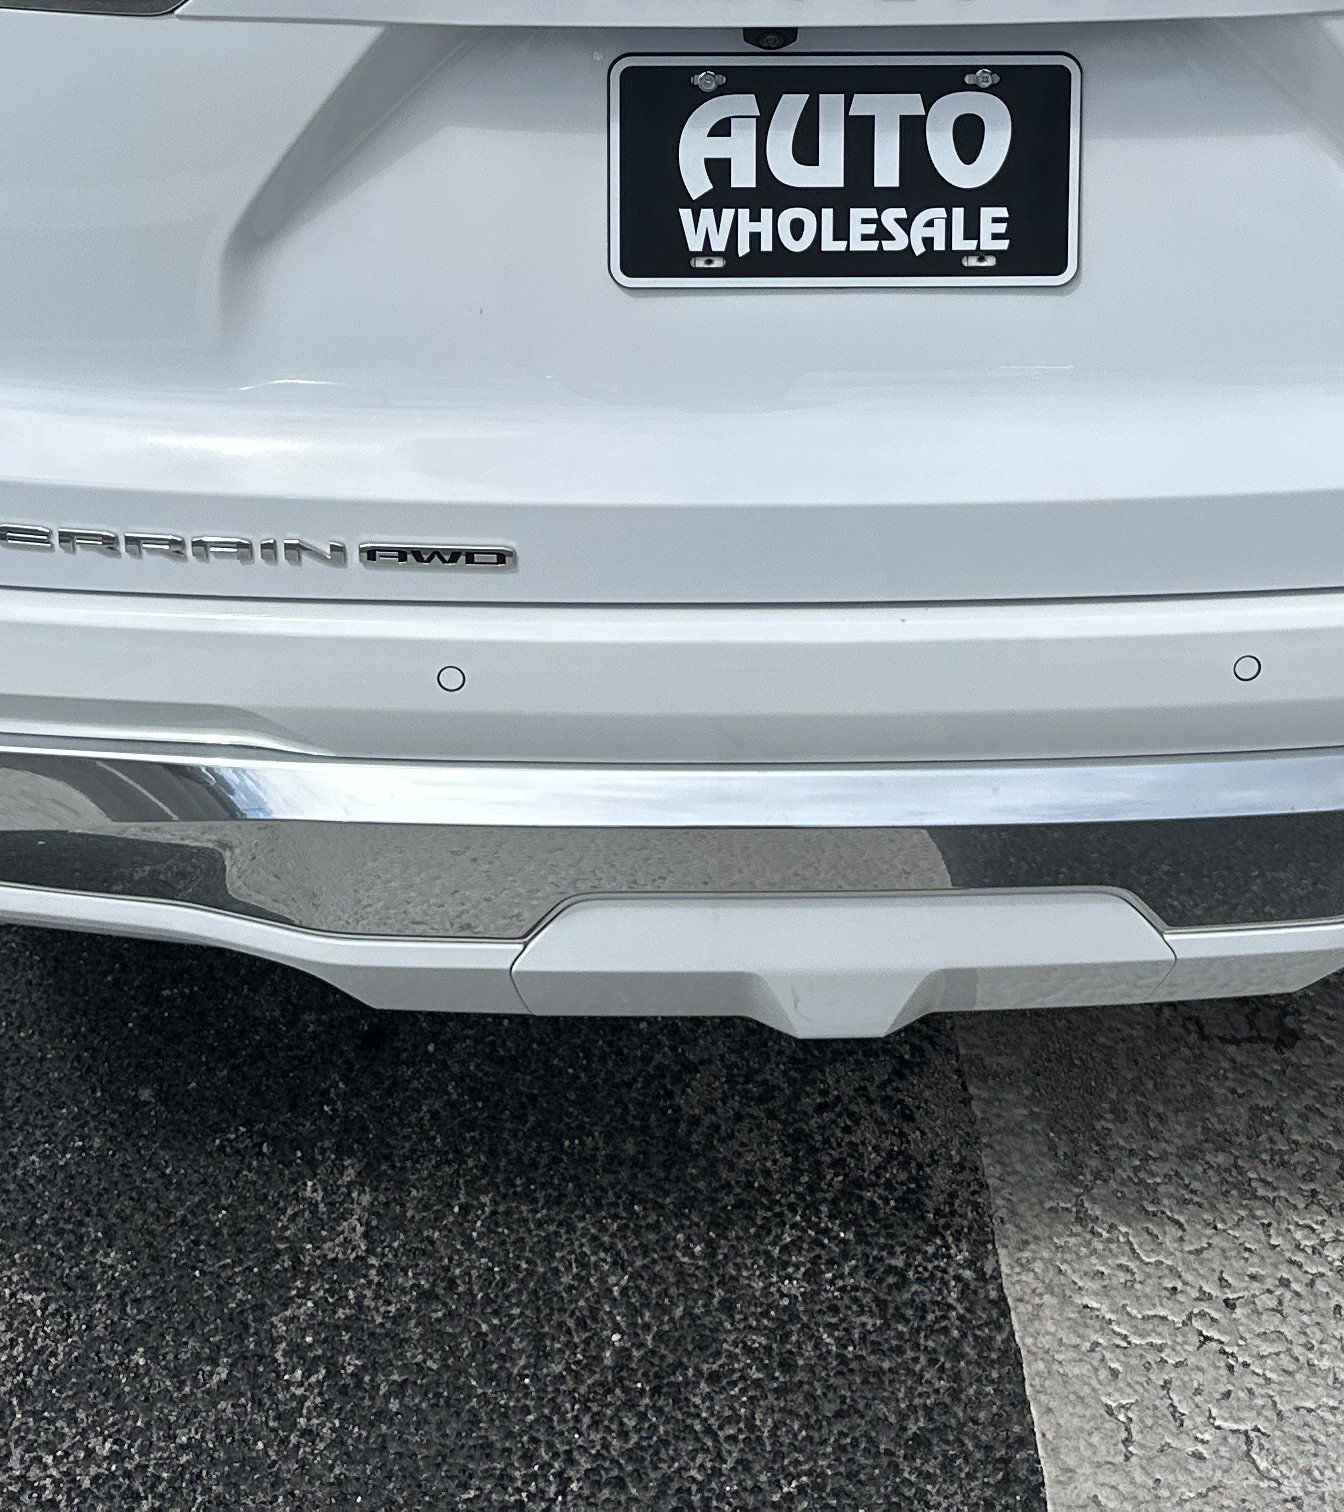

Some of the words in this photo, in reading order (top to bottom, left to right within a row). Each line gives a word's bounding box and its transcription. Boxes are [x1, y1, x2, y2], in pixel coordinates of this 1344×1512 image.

[678, 90, 1013, 201] AUTO
[677, 205, 1011, 258] WHOLESALE
[361, 544, 513, 568] AWD
